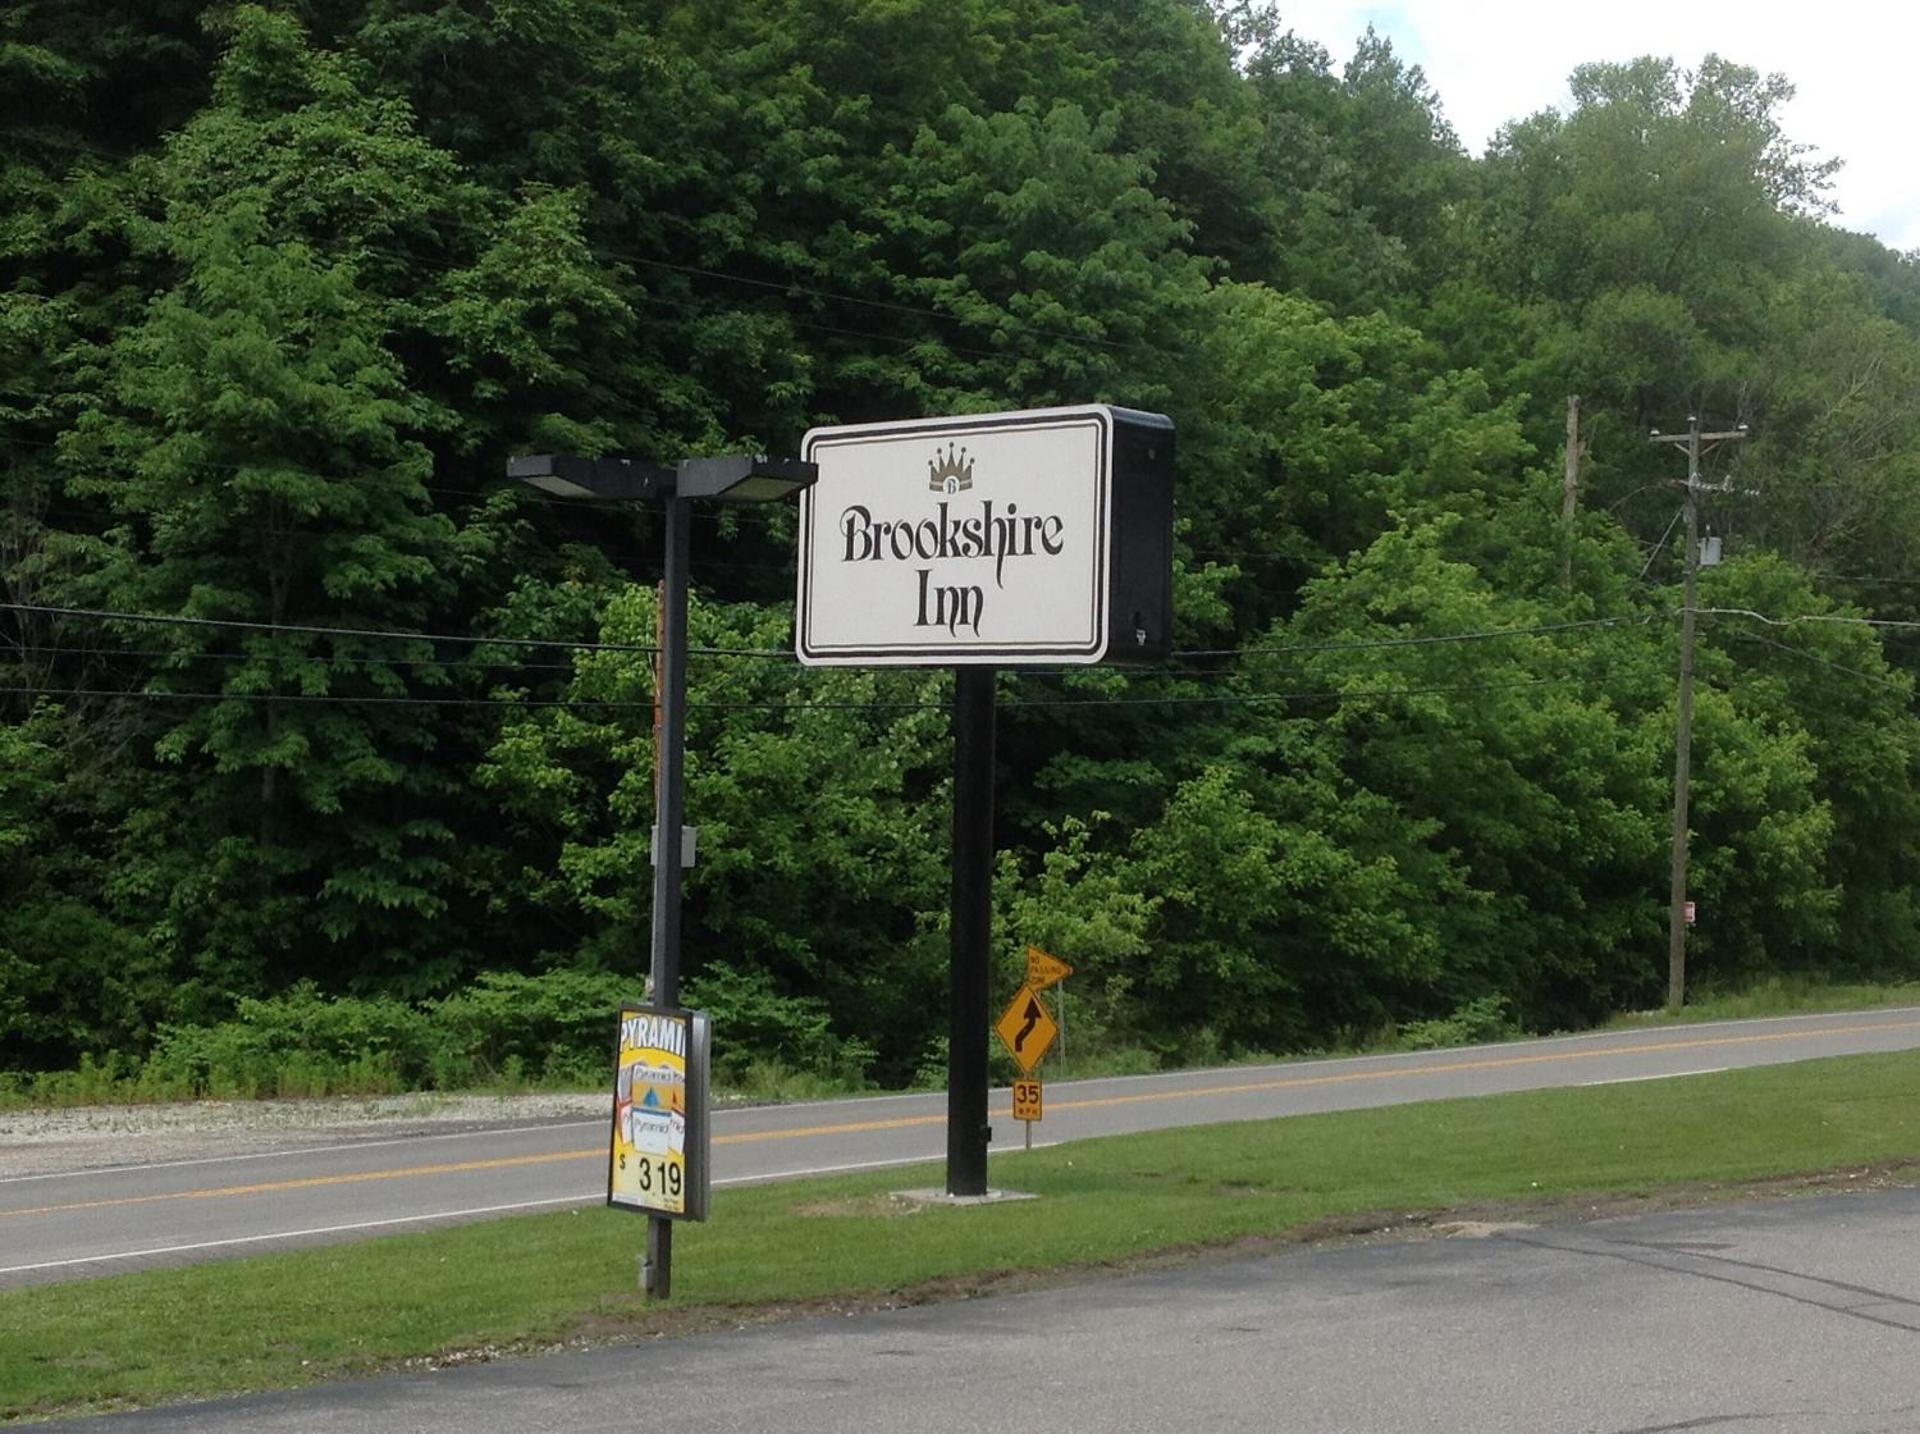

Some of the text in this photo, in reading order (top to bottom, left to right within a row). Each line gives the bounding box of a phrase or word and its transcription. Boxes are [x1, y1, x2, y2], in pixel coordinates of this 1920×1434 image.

[839, 500, 1064, 589] Brookshire
[912, 568, 985, 638] Inn
[620, 1016, 686, 1057] PYRAMI
[1017, 1084, 1039, 1104] 35
